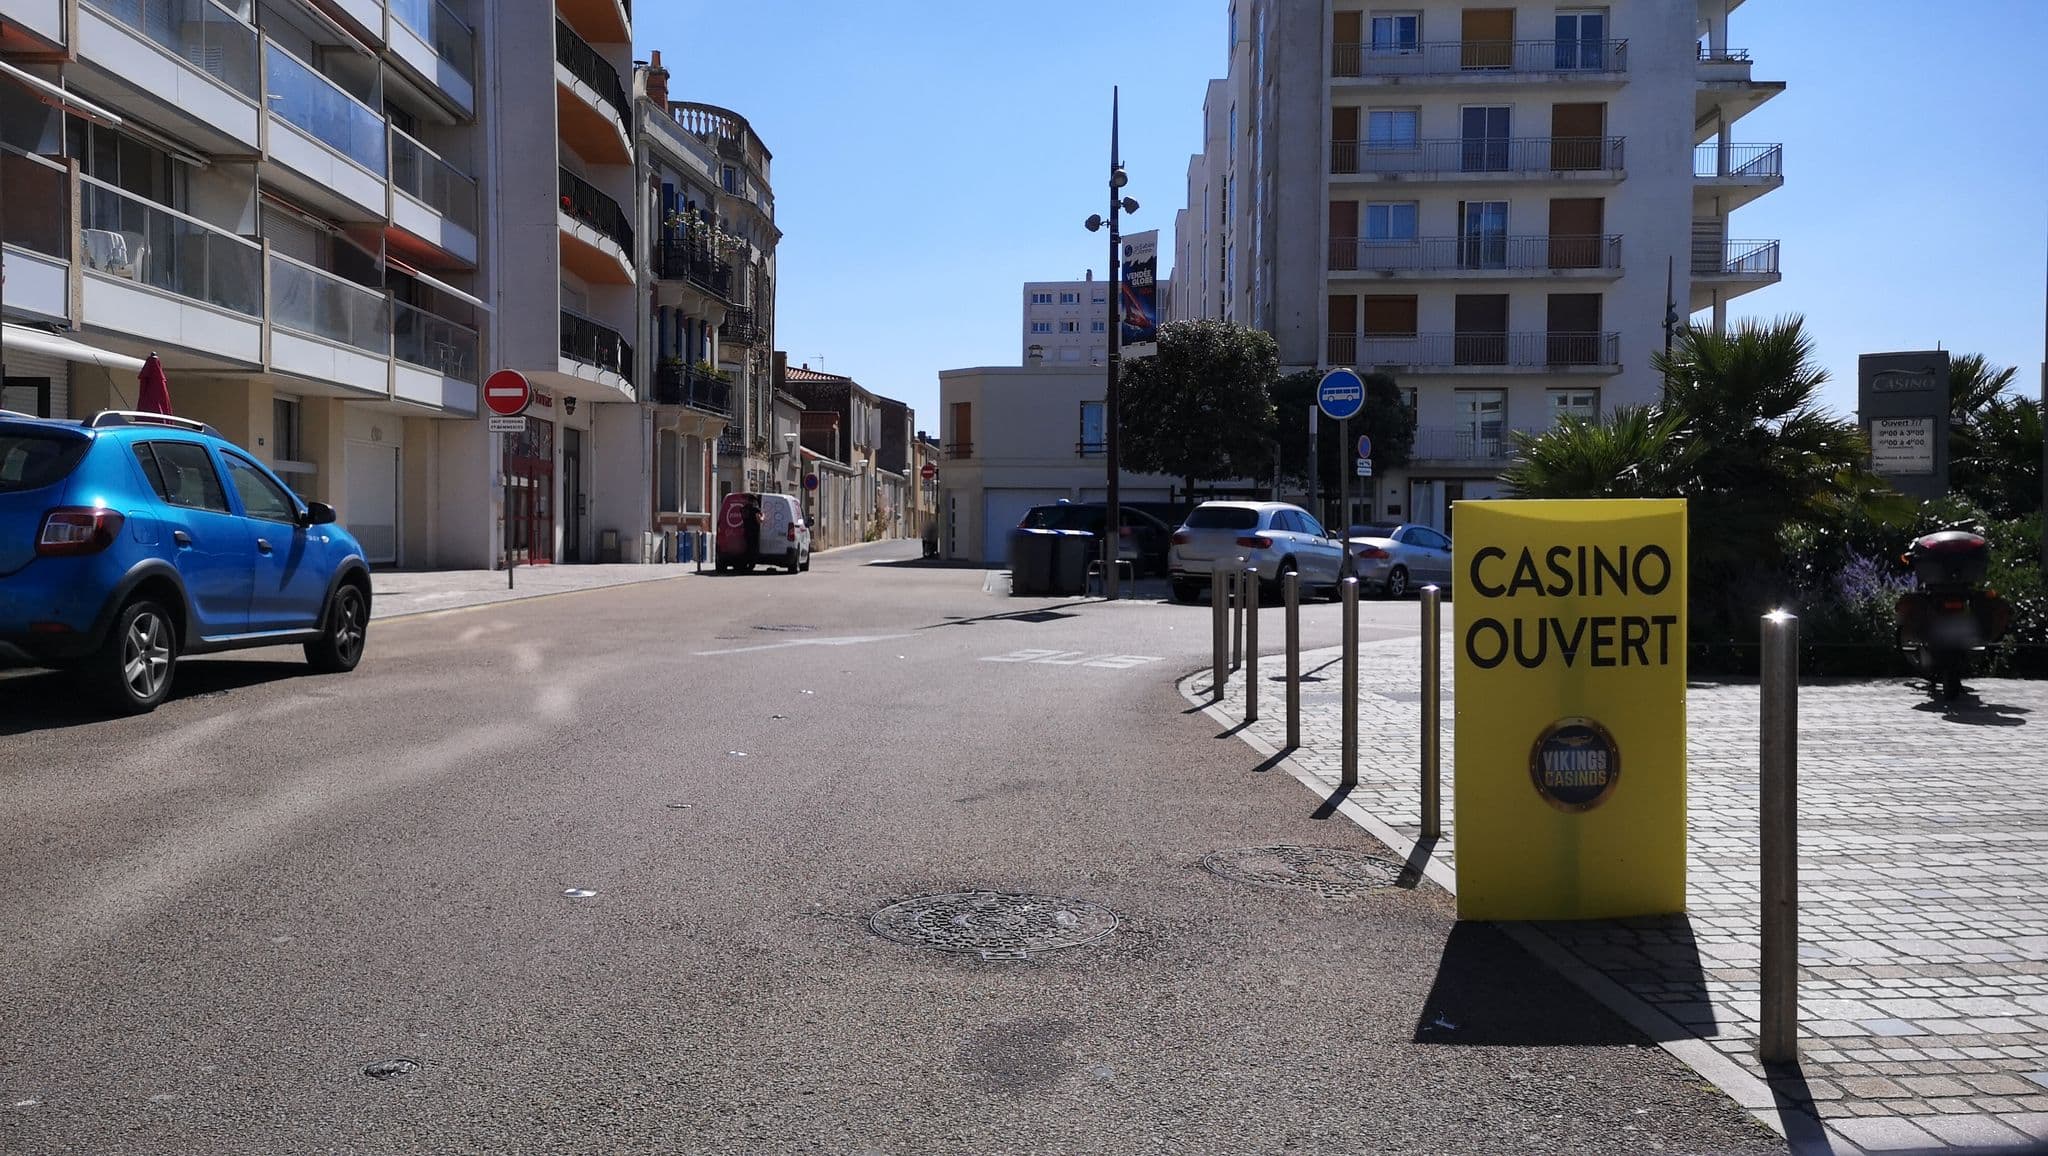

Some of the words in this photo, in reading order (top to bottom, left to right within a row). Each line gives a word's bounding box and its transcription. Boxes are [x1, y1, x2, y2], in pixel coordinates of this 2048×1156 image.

[1126, 268, 1152, 281] VENDÉE
[1131, 277, 1153, 286] GLOBE
[1872, 375, 1936, 392] CASINO
[1470, 544, 1672, 598] CASINO
[1465, 615, 1677, 669] OUVERT
[1542, 750, 1607, 771] VIKINGS
[1545, 770, 1607, 787] CASINOS
